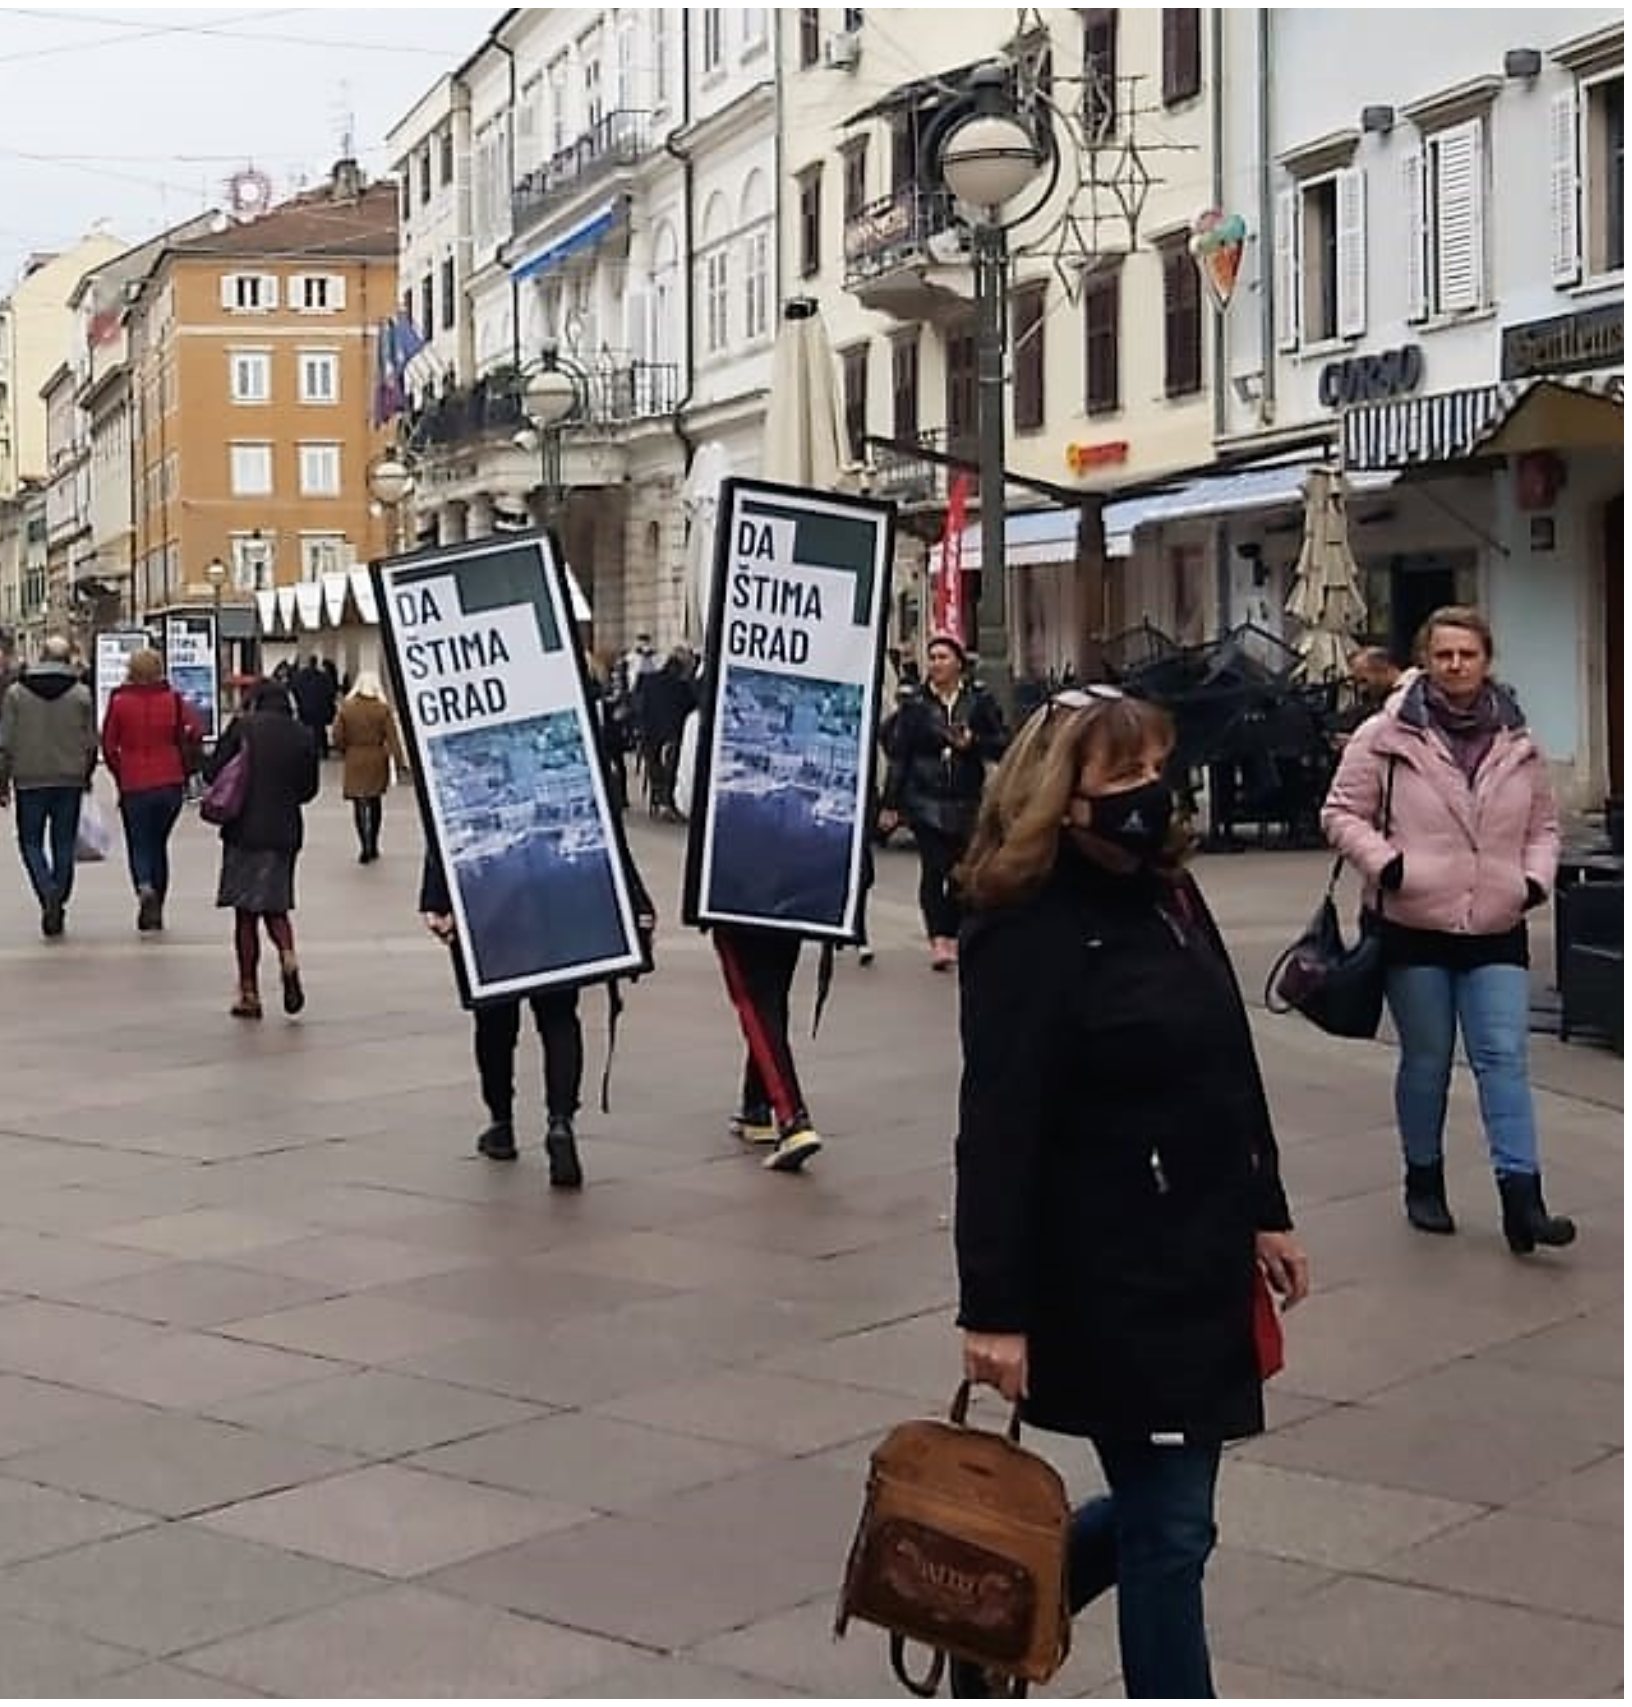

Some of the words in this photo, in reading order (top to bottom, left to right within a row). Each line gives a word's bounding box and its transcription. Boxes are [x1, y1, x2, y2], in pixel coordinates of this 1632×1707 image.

[737, 520, 775, 561] DA
[396, 587, 442, 626] DA
[732, 563, 822, 621] ŠTIMA
[405, 627, 510, 680] ŠTIMA
[728, 619, 809, 664] GRAD
[417, 676, 507, 726] GRAD
